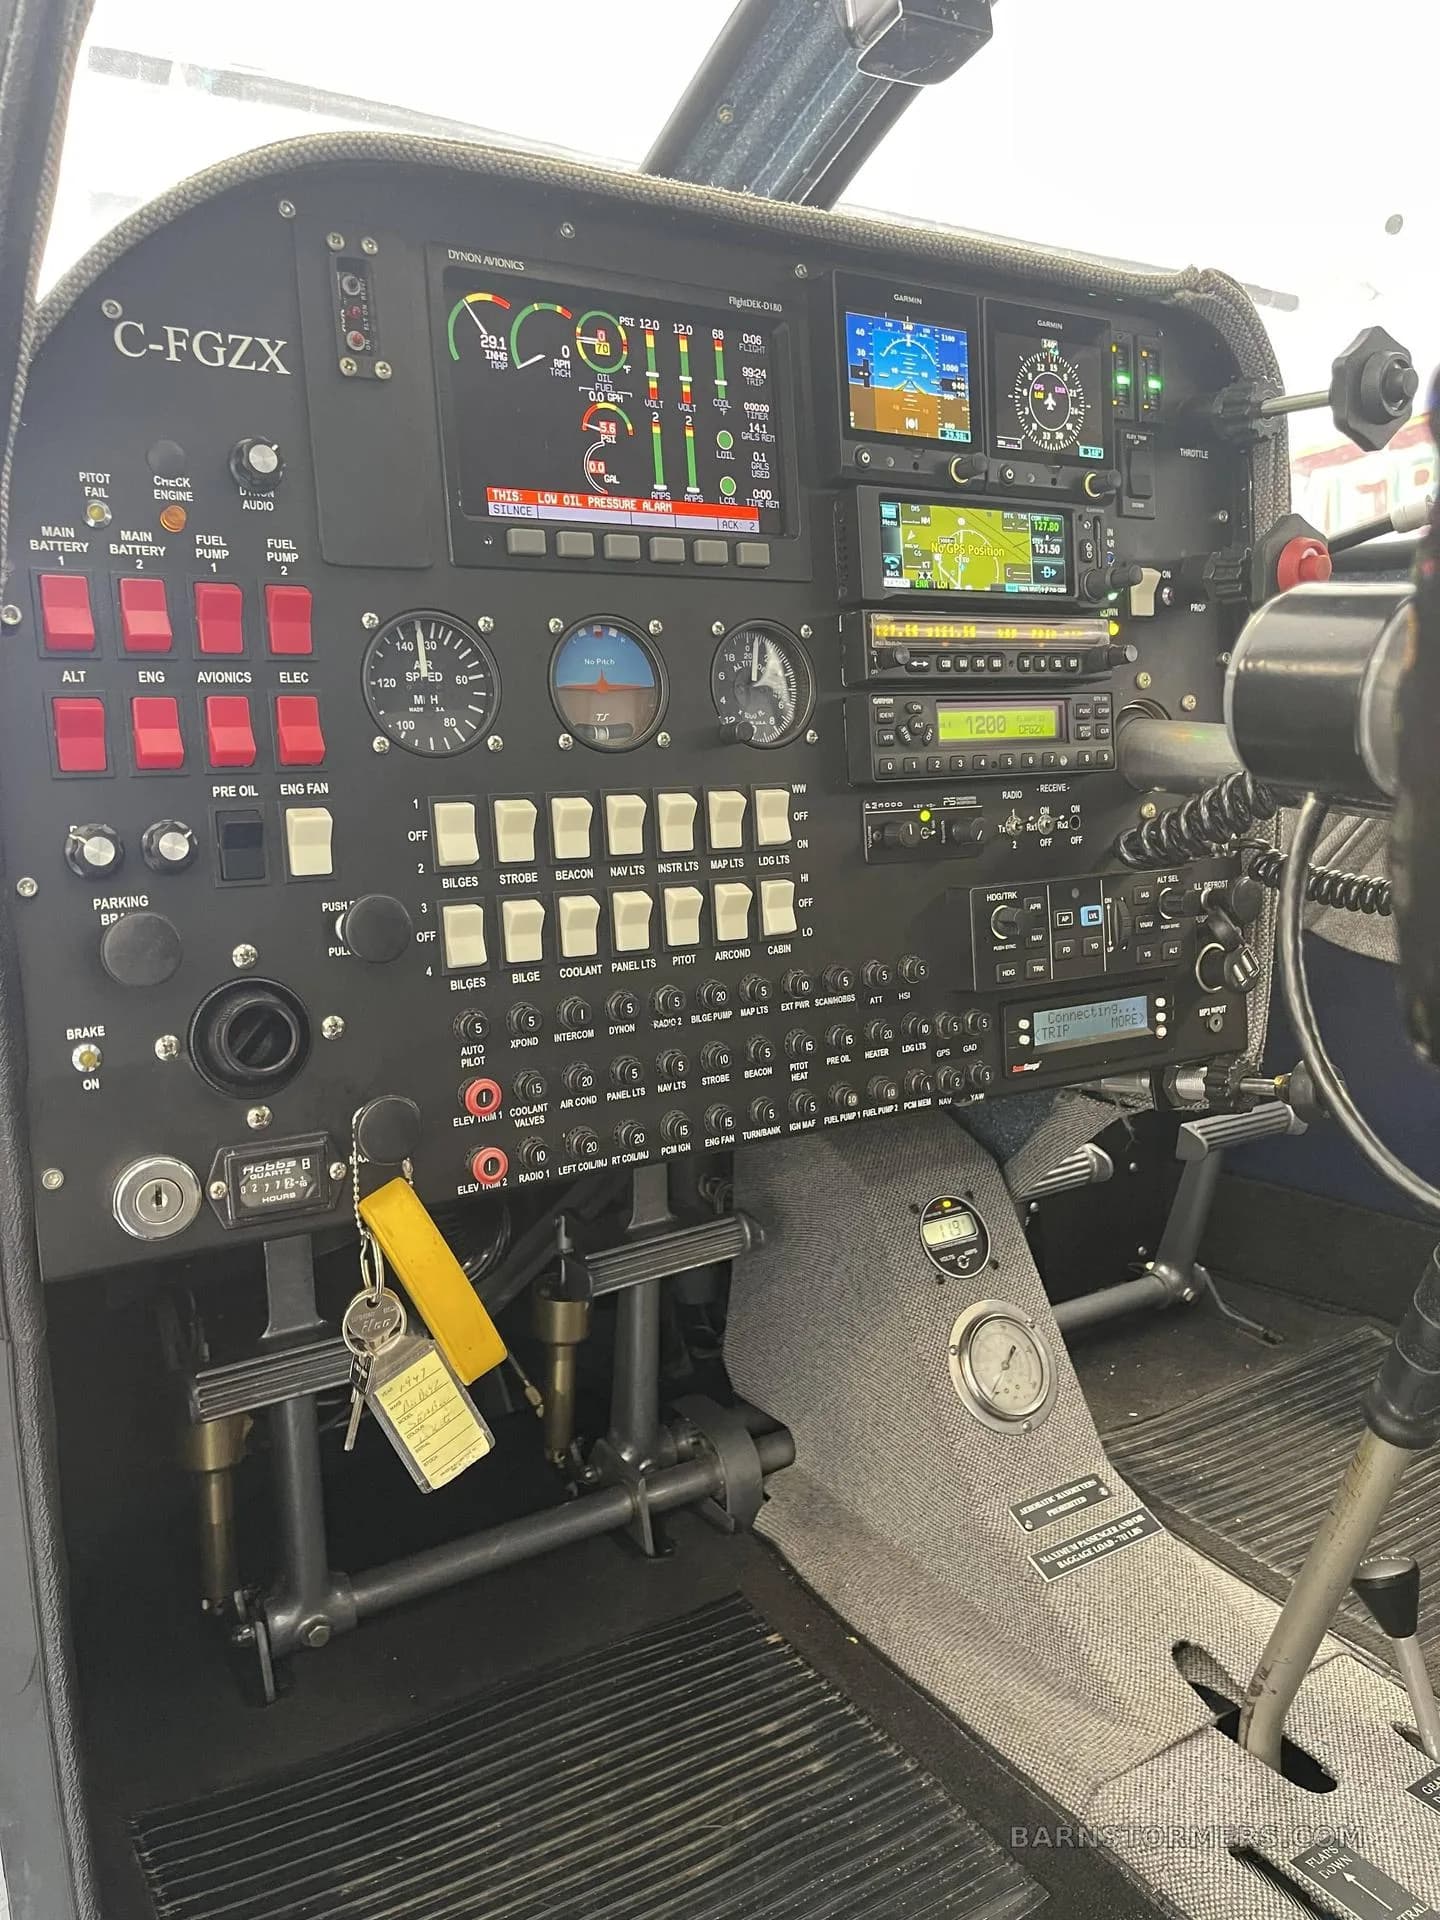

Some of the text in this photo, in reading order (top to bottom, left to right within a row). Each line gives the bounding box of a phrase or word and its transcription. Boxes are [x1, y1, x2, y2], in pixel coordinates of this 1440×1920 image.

[448, 249, 525, 271] DYNON AVIONICS
[619, 316, 634, 327] PSI
[639, 319, 660, 331] 12.0
[673, 323, 693, 335] 12.0
[712, 329, 724, 340] 68
[480, 334, 507, 350] 29.1
[743, 333, 761, 346] 0:06
[113, 320, 292, 375] C-FGZX
[739, 343, 765, 354] FLIGHT
[485, 350, 508, 361] INHG
[554, 359, 571, 369] RPM
[550, 368, 571, 378] TACH
[742, 367, 767, 380] 99:24
[1180, 448, 1209, 460] THROTTLE
[79, 472, 111, 485] PITOT
[153, 475, 191, 488] CHECK
[85, 486, 108, 498] FAIL
[153, 489, 193, 502] ENGINE
[243, 500, 274, 512] AUDIO
[493, 489, 672, 512] THIS: LOW OIL PRESSURE ALARM
[494, 505, 532, 516] SILNCE
[41, 526, 75, 538] MAIN
[120, 530, 153, 543] MAIN
[30, 540, 89, 553] BATTERY
[196, 535, 227, 547] FUEL
[267, 539, 297, 550] FUEL
[109, 544, 166, 557] BATTERY
[196, 548, 230, 560] PUMP
[931, 543, 1005, 557] No GPS Position
[1035, 544, 1060, 555] 121.50
[58, 556, 64, 566] 1
[267, 552, 299, 563] PUMP
[136, 559, 144, 570] 2
[211, 563, 217, 573] 1
[281, 566, 288, 576] 2
[1191, 604, 1206, 612] PROP
[396, 642, 414, 651] 140
[584, 658, 615, 666] No Pitch
[62, 671, 86, 683] ALT
[139, 672, 165, 684] ENG
[197, 672, 252, 684] AVIONICS
[279, 672, 309, 684] ELEC
[378, 678, 396, 688] 120
[456, 675, 468, 685] 60
[396, 721, 415, 730] 100
[444, 718, 456, 727] 80
[966, 716, 1006, 735] 1200
[212, 785, 259, 797] PRE OIL
[280, 782, 329, 796] ENG FAN
[792, 784, 807, 794] WW
[1002, 790, 1022, 800] RADIO
[413, 799, 418, 809] 1
[793, 811, 808, 821] OFF
[408, 831, 428, 841] OFF
[797, 840, 808, 849] ON
[710, 858, 744, 870] MAP LTS
[758, 855, 790, 866] LDG LTS
[418, 863, 424, 874] 2
[610, 864, 645, 877] NAV LTS
[658, 862, 699, 874] INSTR LTS
[499, 872, 538, 885] STROBE
[555, 869, 594, 881] BEACON
[800, 873, 809, 883] HI
[1168, 875, 1179, 883] SEL
[442, 876, 478, 888] BILGES
[93, 895, 149, 910] PARKING
[986, 891, 1018, 902] HDG/TRK
[421, 903, 428, 913] 3
[798, 898, 813, 908] OFF
[416, 932, 436, 942] OFF
[802, 927, 813, 937] LO
[715, 948, 750, 961] AIRCOND
[767, 944, 791, 955] CABIN
[611, 959, 656, 973] PANEL LTS
[672, 954, 696, 966] PITOT
[426, 966, 432, 977] 4
[559, 964, 603, 978] COOLANT
[450, 977, 486, 991] BILGES
[512, 972, 541, 984] BILGE
[781, 1000, 810, 1012] EXT PWR
[870, 996, 883, 1004] ATT
[740, 1005, 769, 1017] MAP LTS
[1048, 1005, 1136, 1024] Connecting...
[691, 1011, 732, 1024] BILGE PUMP
[66, 1025, 105, 1040] BRAKE
[609, 1024, 635, 1035] DYNON
[554, 1029, 594, 1043] INTERCOM
[511, 1037, 538, 1048] XPOND
[902, 1042, 927, 1053] LDG LTS
[461, 1045, 484, 1056] AUTO
[865, 1048, 889, 1059] HEATER
[461, 1056, 485, 1068] PILOT
[827, 1054, 851, 1065] PRE OIL
[790, 1061, 808, 1071] PITOT
[744, 1067, 773, 1078] BEACON
[791, 1072, 808, 1082] HEAT
[82, 1078, 99, 1090] ON
[702, 1074, 730, 1086] STROBE
[658, 1080, 687, 1093] NAV LTS
[606, 1087, 646, 1101] PANEL LTS
[560, 1095, 597, 1109] AIR COND
[510, 1103, 548, 1117] COOLANT
[514, 1115, 545, 1128] VALVES
[742, 1126, 781, 1140] TURN/BANK
[705, 1134, 735, 1147] ENG FAN
[243, 1160, 297, 1175] Hobbs
[558, 1158, 607, 1176] LEFT COIL/INJ
[250, 1168, 291, 1180] QUARTZ
[262, 1192, 296, 1203] HOURS
[1305, 1845, 1339, 1869] FLAPS
[1318, 1854, 1353, 1879] DOWN
